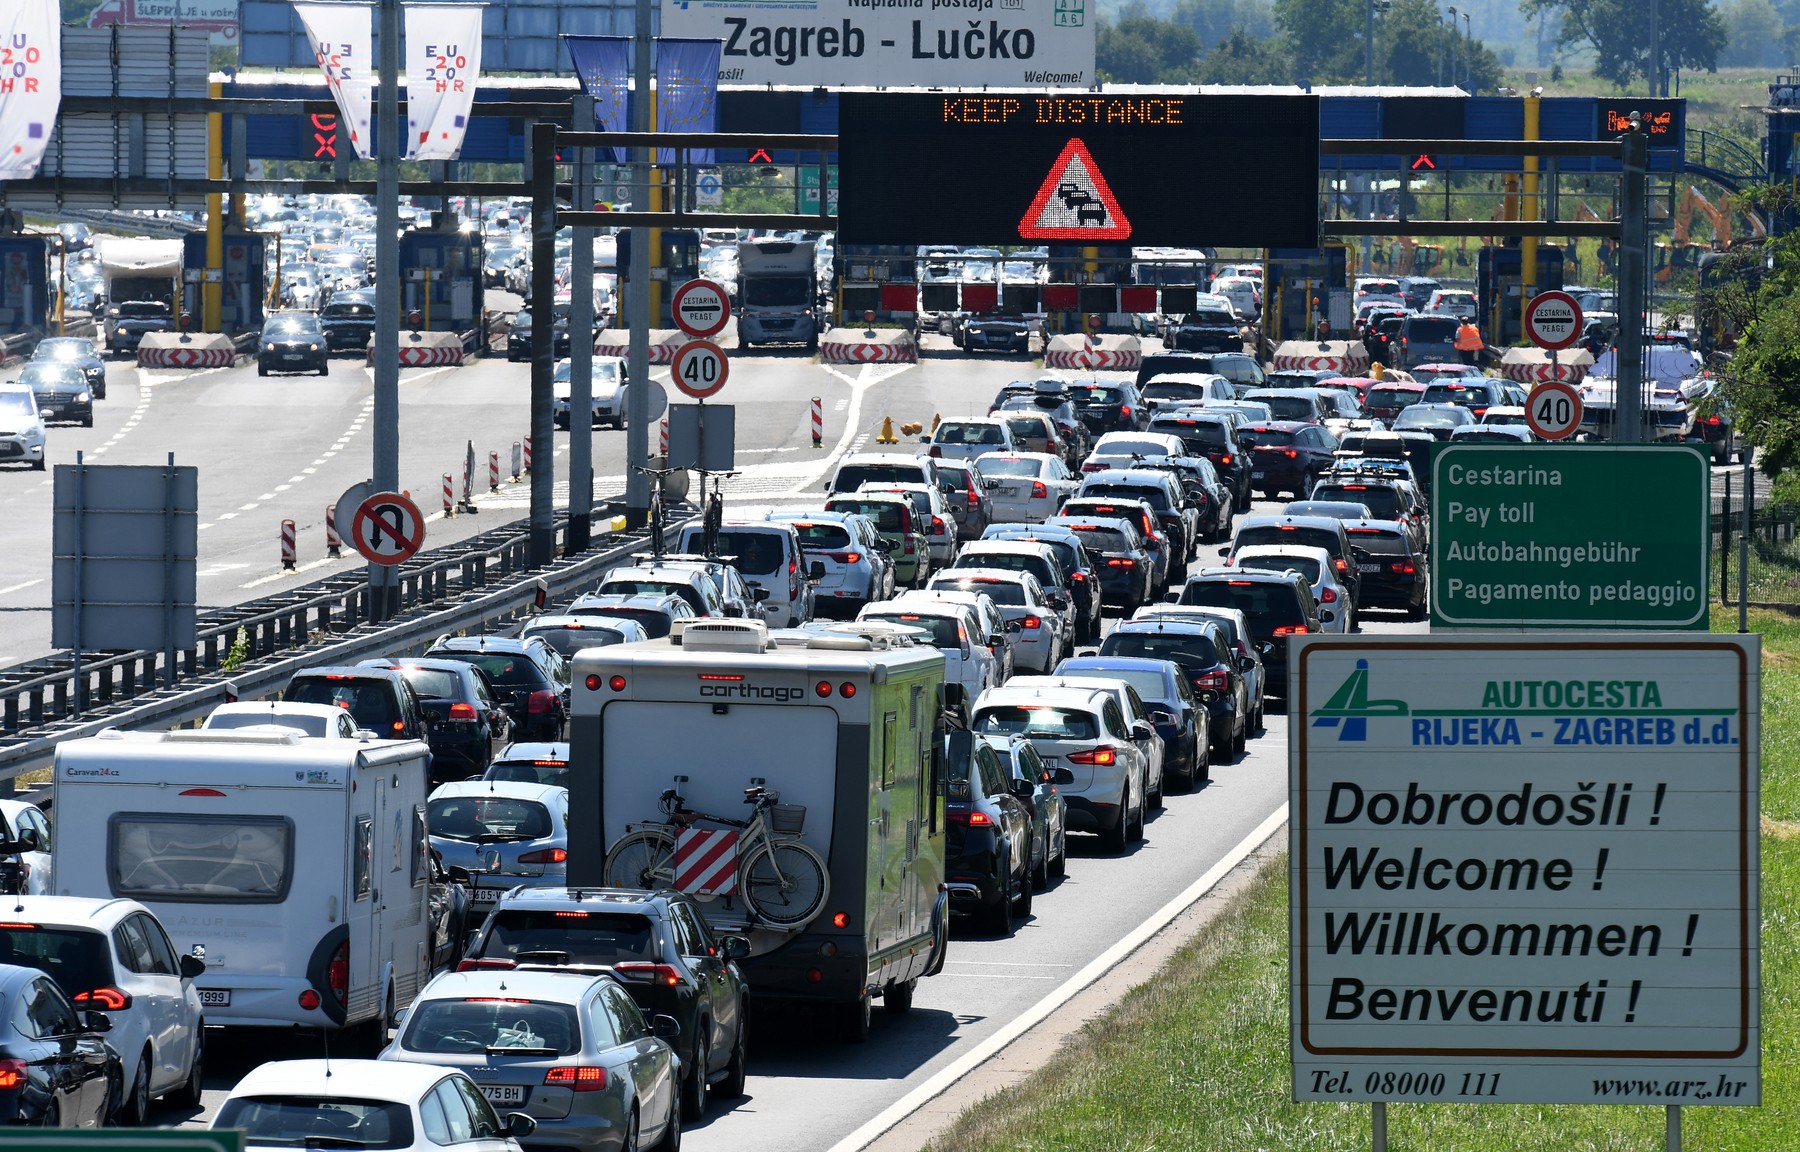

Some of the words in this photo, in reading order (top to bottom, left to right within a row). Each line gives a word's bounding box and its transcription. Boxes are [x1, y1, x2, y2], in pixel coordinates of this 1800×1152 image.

[724, 17, 865, 66] Zagreb
[912, 20, 1035, 60] Lučko
[1024, 71, 1083, 83] Welcome!
[944, 98, 1020, 123] KEEP
[1035, 99, 1184, 124] DISTANCE
[683, 297, 718, 305] CESTARINA
[1536, 309, 1571, 317] CESTARINA
[690, 313, 713, 321] PEAGE
[1542, 324, 1565, 333] PEAGE
[684, 355, 716, 382] 40
[1537, 398, 1570, 425] 40
[1449, 464, 1562, 486] Cestarina
[1448, 502, 1491, 528] Pay
[1498, 502, 1535, 523] toll
[1447, 541, 1641, 568] Autobahngebühr
[1448, 578, 1581, 605] Pagamento
[1589, 580, 1696, 607] pedaggio
[700, 683, 804, 702] carthago
[1481, 681, 1663, 708] AUTOCESTA
[1412, 718, 1521, 746] RIJEKA
[1553, 718, 1676, 745] ZAGREB
[1683, 718, 1739, 745] d.d.
[67, 767, 120, 777] Caravan24.cz
[1324, 781, 1633, 826] Dobrodošli
[1323, 846, 1573, 891] Welcome
[1324, 911, 1662, 957] Willkommen
[198, 991, 225, 1002] 1999
[1325, 977, 1608, 1023] Benvenuti
[504, 1087, 519, 1100] BH
[1310, 1070, 1354, 1094] Tel.
[1365, 1071, 1446, 1096] 08000
[1459, 1072, 1502, 1097] 111
[1592, 1074, 1748, 1100] www.arz.hr
